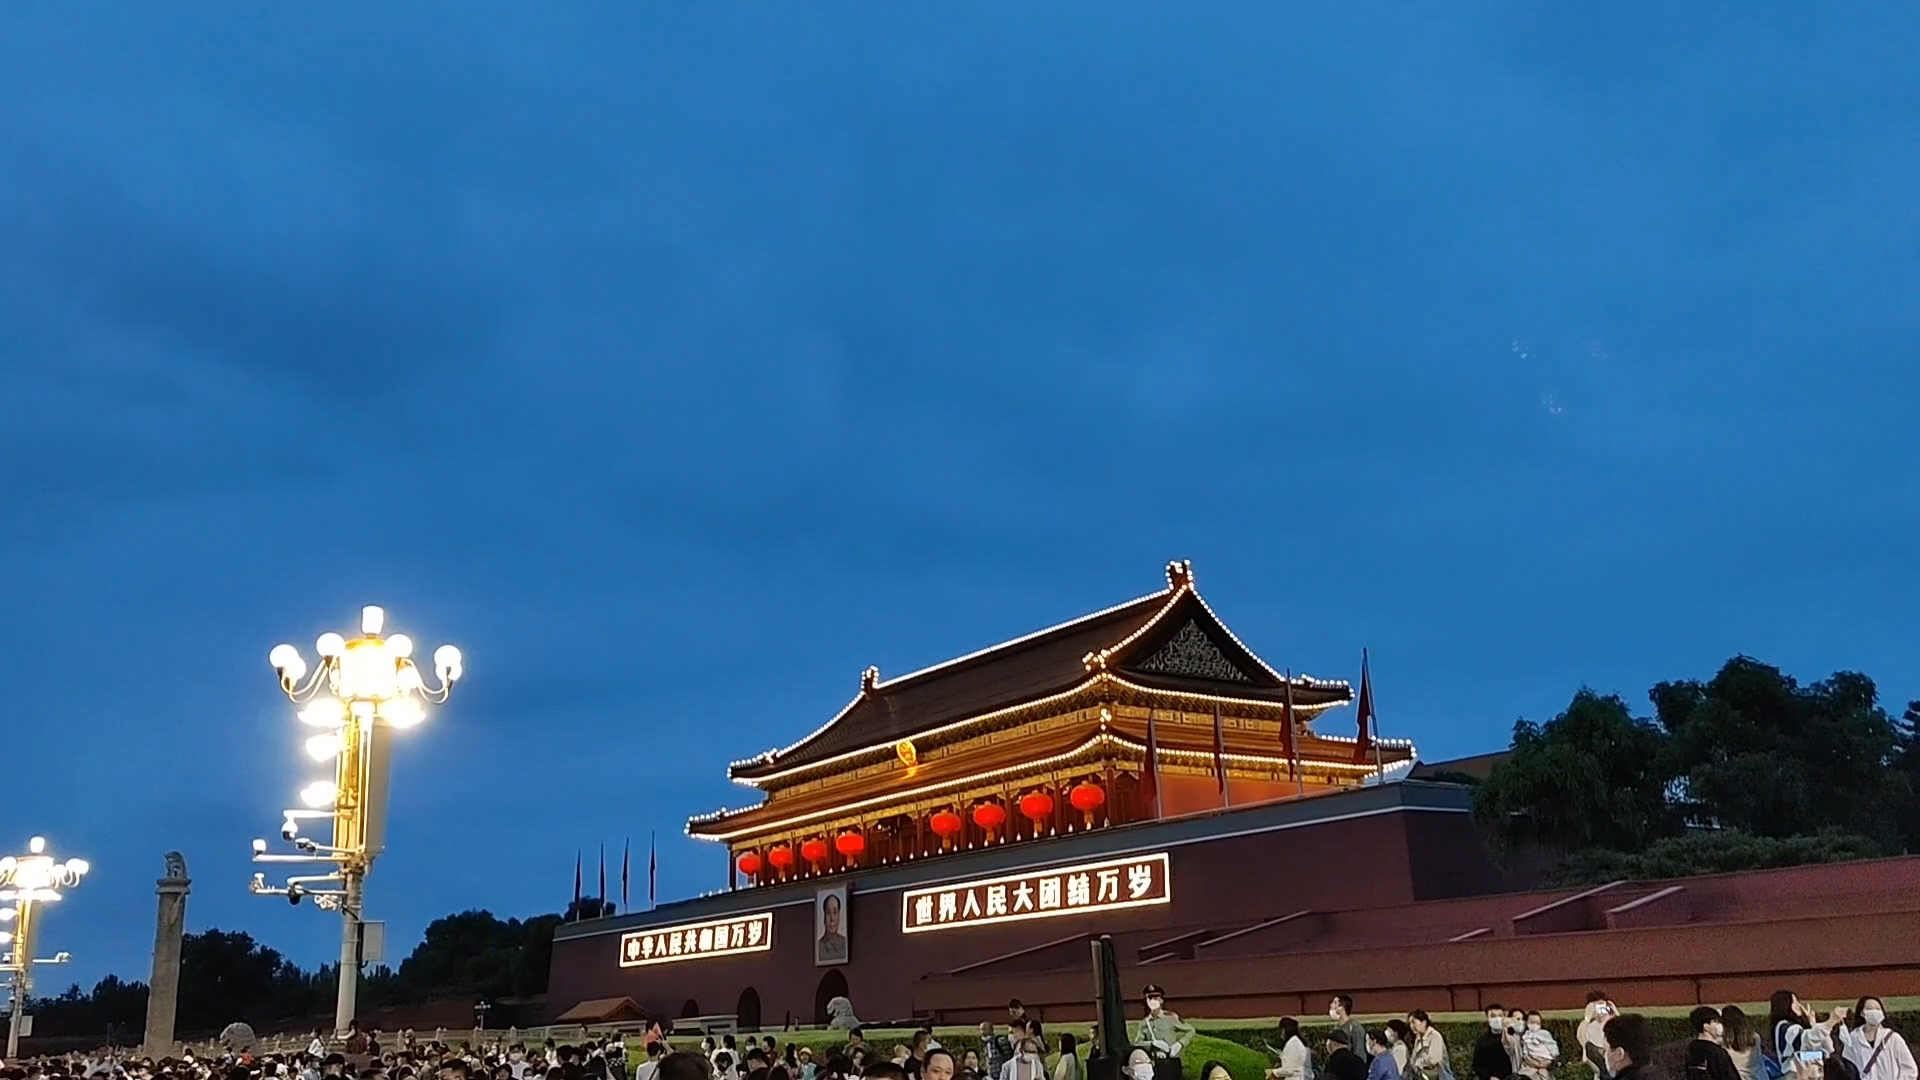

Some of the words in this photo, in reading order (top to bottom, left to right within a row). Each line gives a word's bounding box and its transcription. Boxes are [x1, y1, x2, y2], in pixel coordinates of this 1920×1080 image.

[915, 865, 1152, 925] 世界人民大团结万岁
[627, 920, 763, 961] 中华人民共和国万岁
